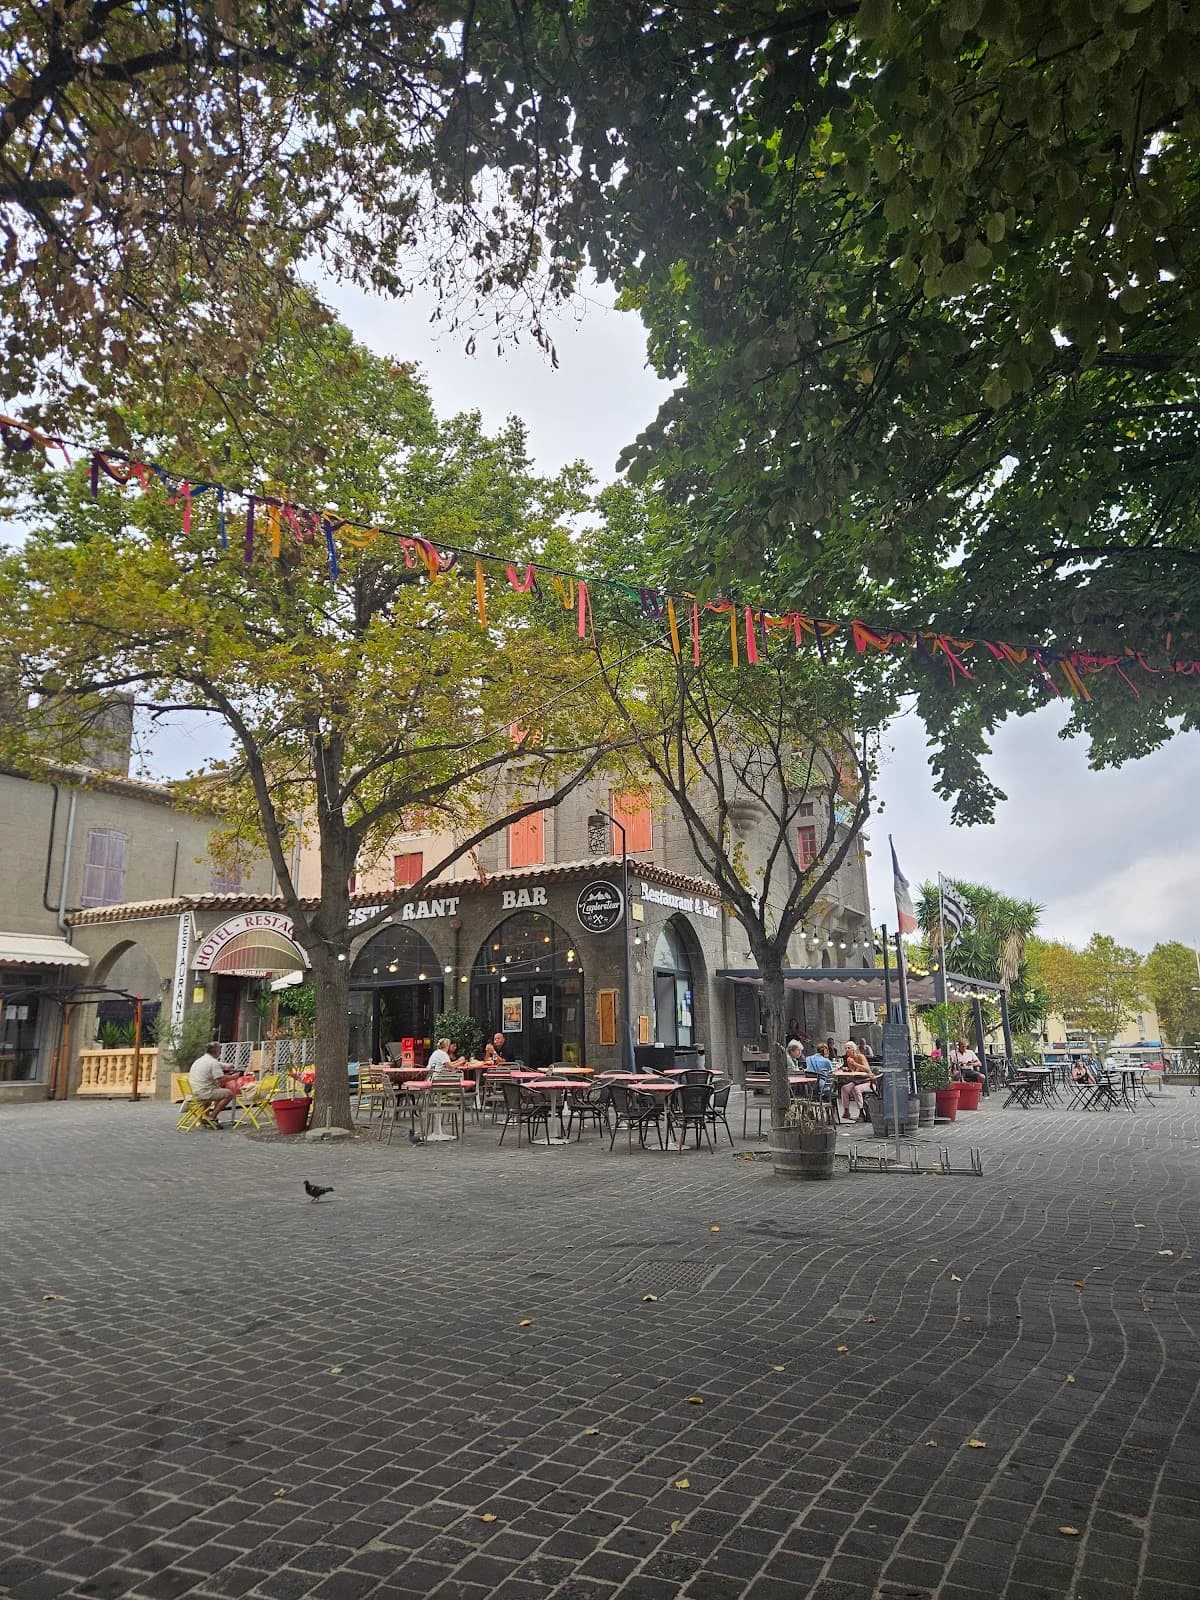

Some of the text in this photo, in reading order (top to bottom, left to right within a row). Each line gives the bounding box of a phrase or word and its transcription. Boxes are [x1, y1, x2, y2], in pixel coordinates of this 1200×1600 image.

[502, 886, 548, 910] BAR
[640, 881, 694, 913] Restaurant
[702, 899, 718, 919] Bar
[196, 926, 234, 967] HOTEL
[244, 914, 295, 938] RESTA
